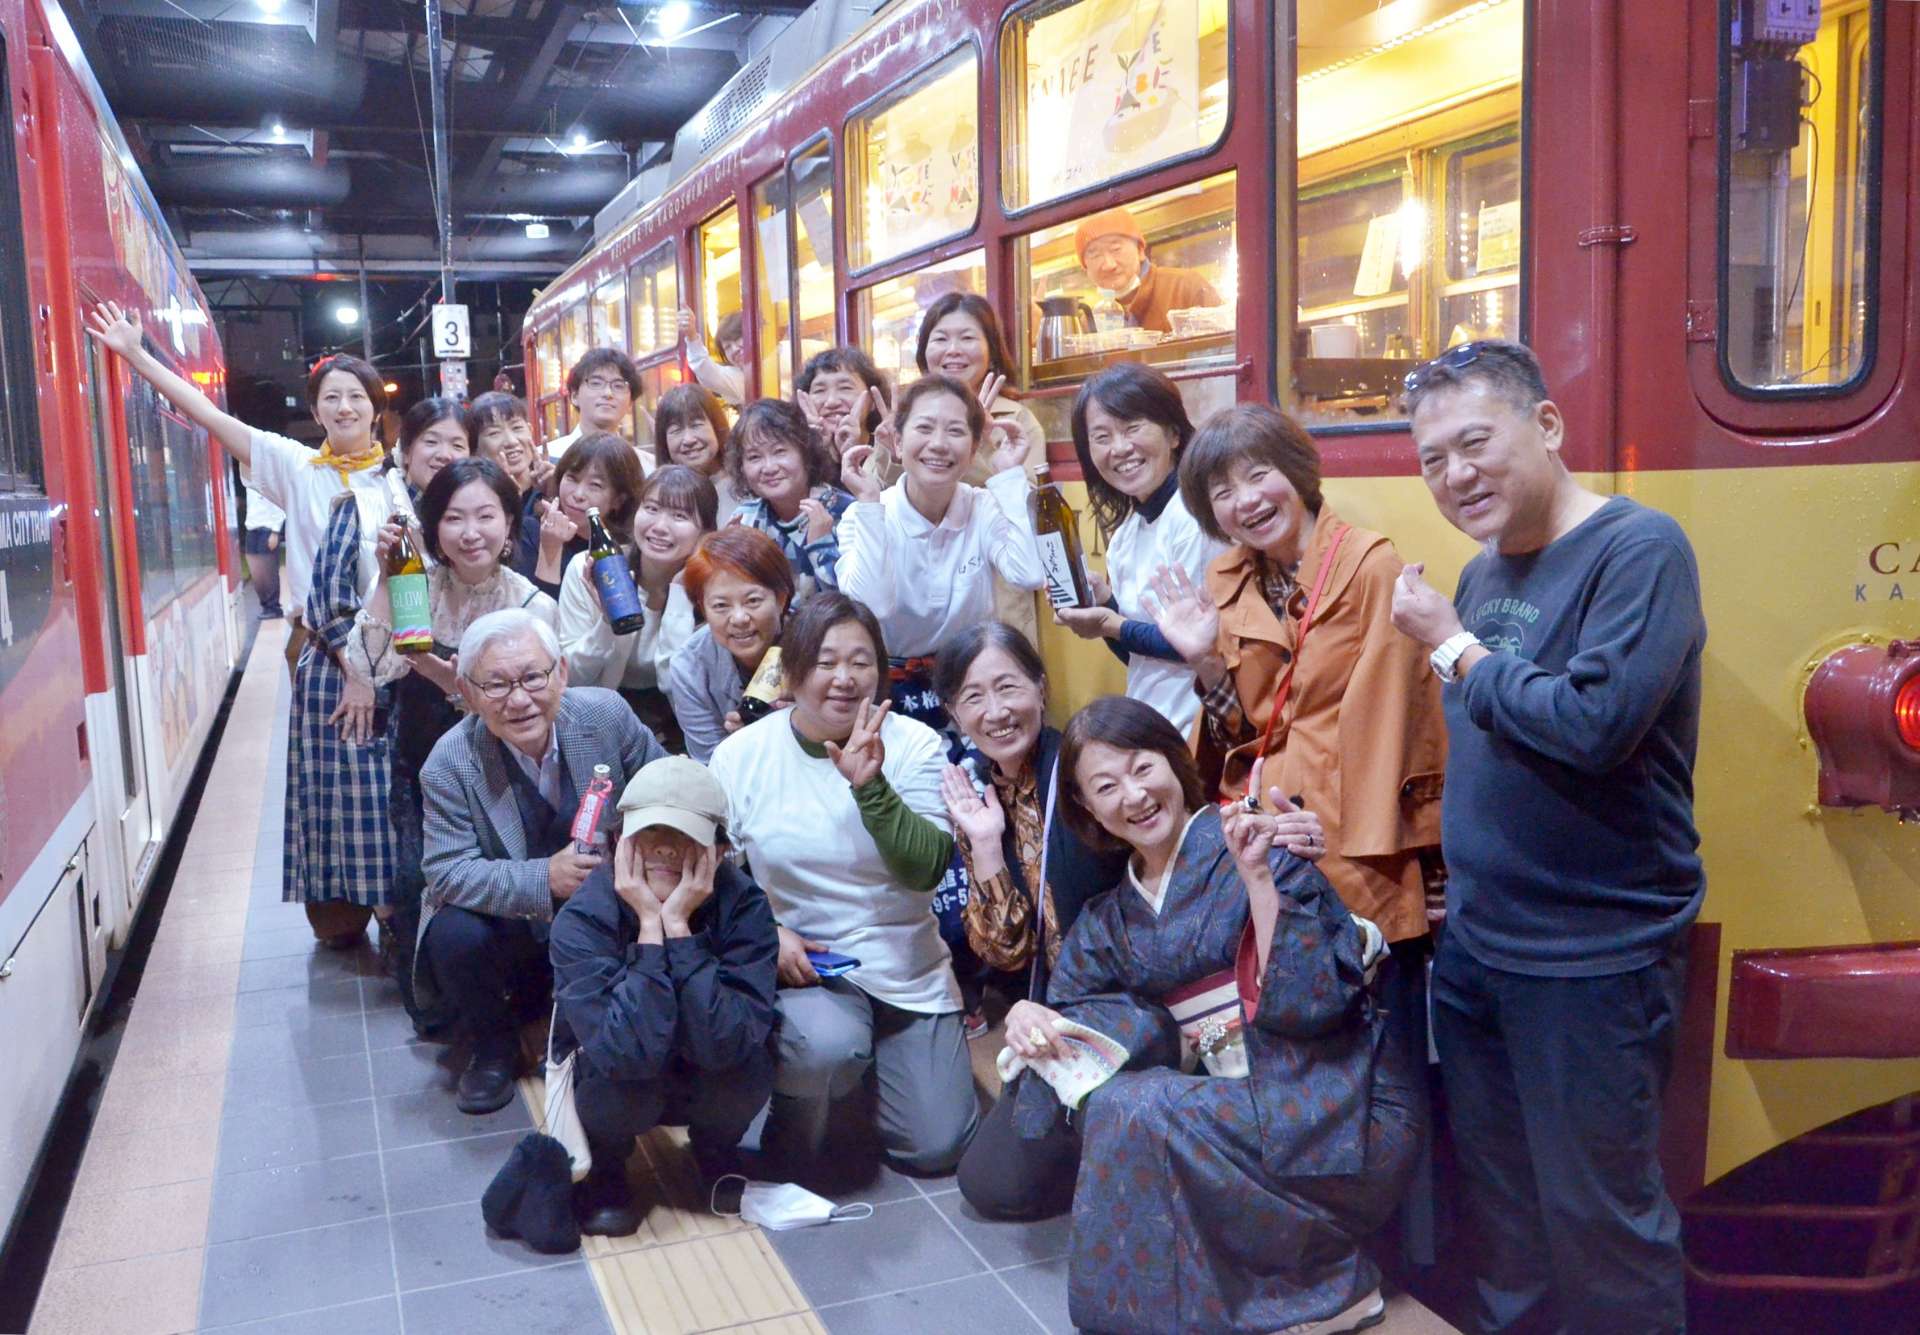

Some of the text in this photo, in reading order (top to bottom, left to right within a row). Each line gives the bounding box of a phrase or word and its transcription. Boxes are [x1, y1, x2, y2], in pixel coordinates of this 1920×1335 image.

[444, 320, 460, 346] 3
[13, 510, 30, 546] CITY
[392, 591, 424, 609] GLOW
[1501, 598, 1541, 624] BRAND
